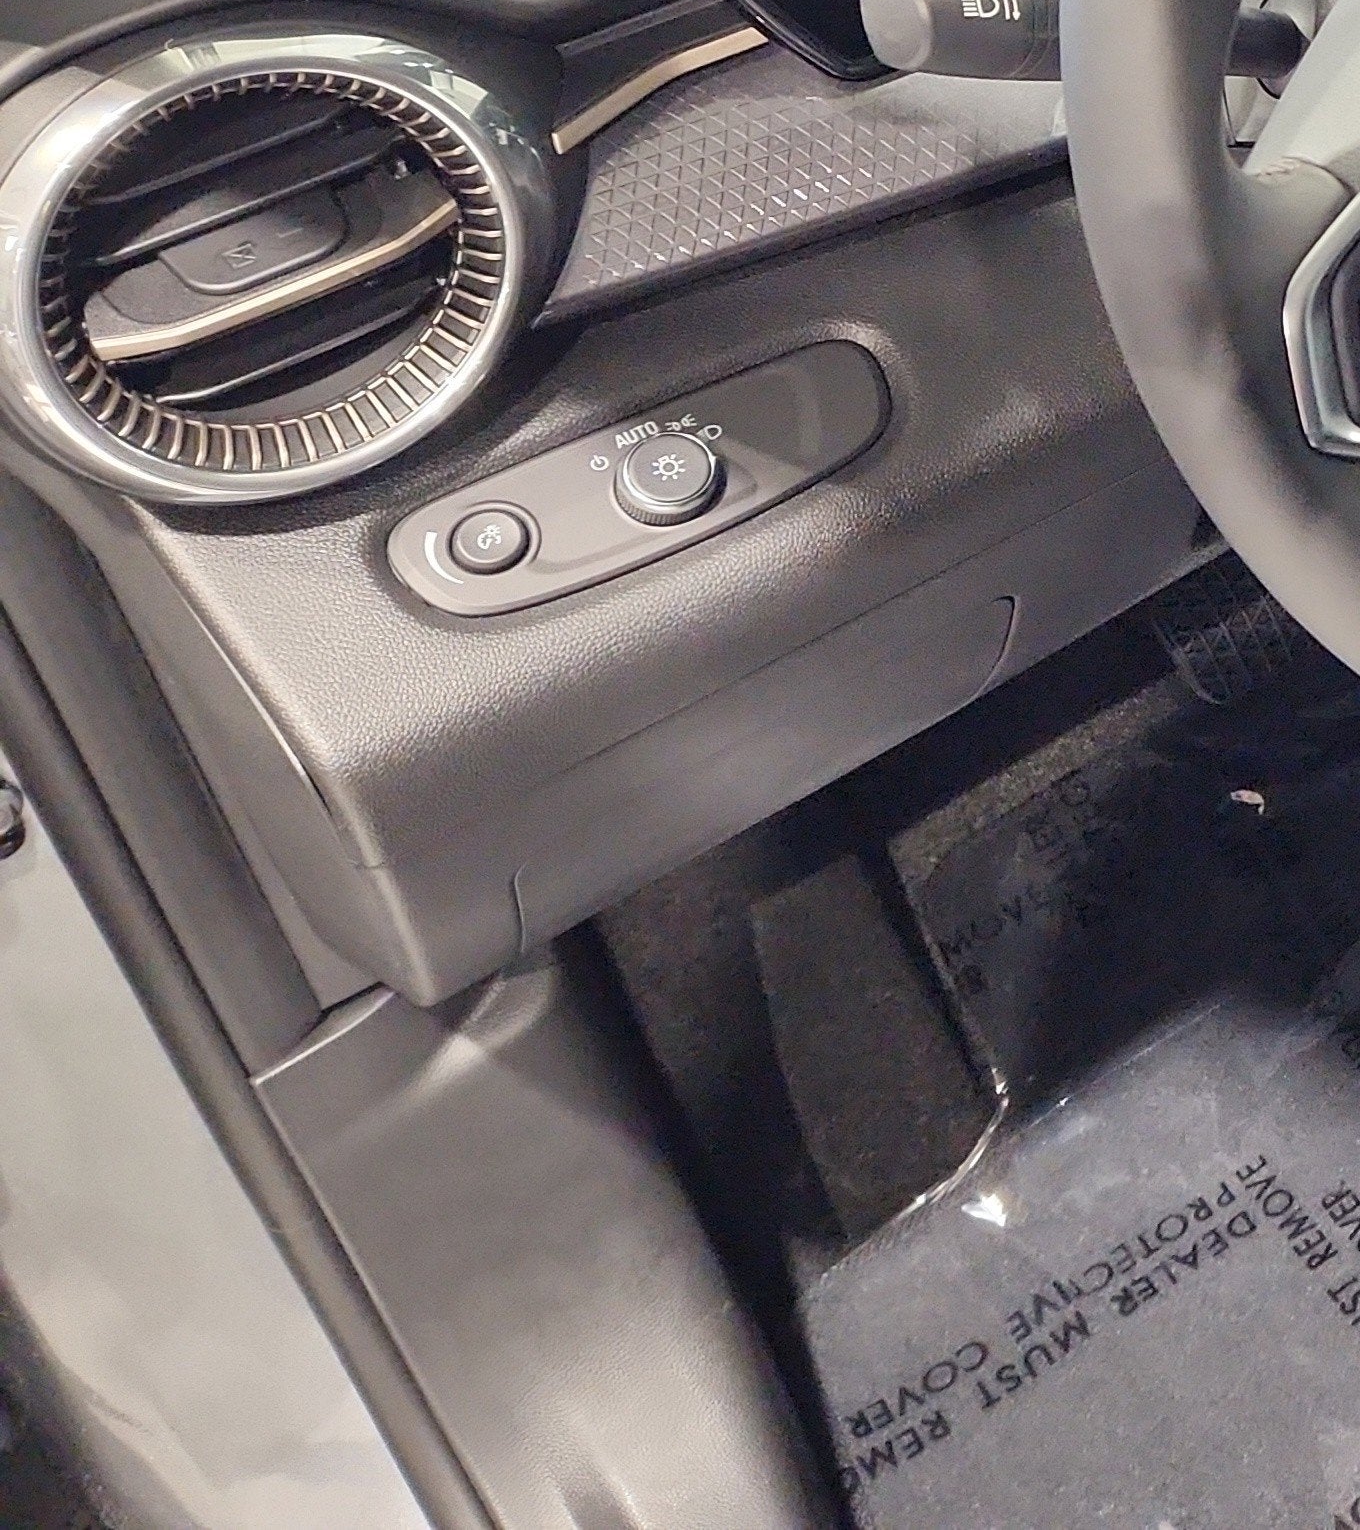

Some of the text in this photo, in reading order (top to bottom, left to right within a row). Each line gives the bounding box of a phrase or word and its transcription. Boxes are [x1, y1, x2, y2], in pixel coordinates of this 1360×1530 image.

[614, 421, 659, 449] AUTO
[1110, 1210, 1259, 1318] DEALER
[1236, 1155, 1338, 1270] REMOVE
[844, 1182, 1237, 1439] PROTECTIVE COVER
[975, 1310, 1091, 1410] MUST
